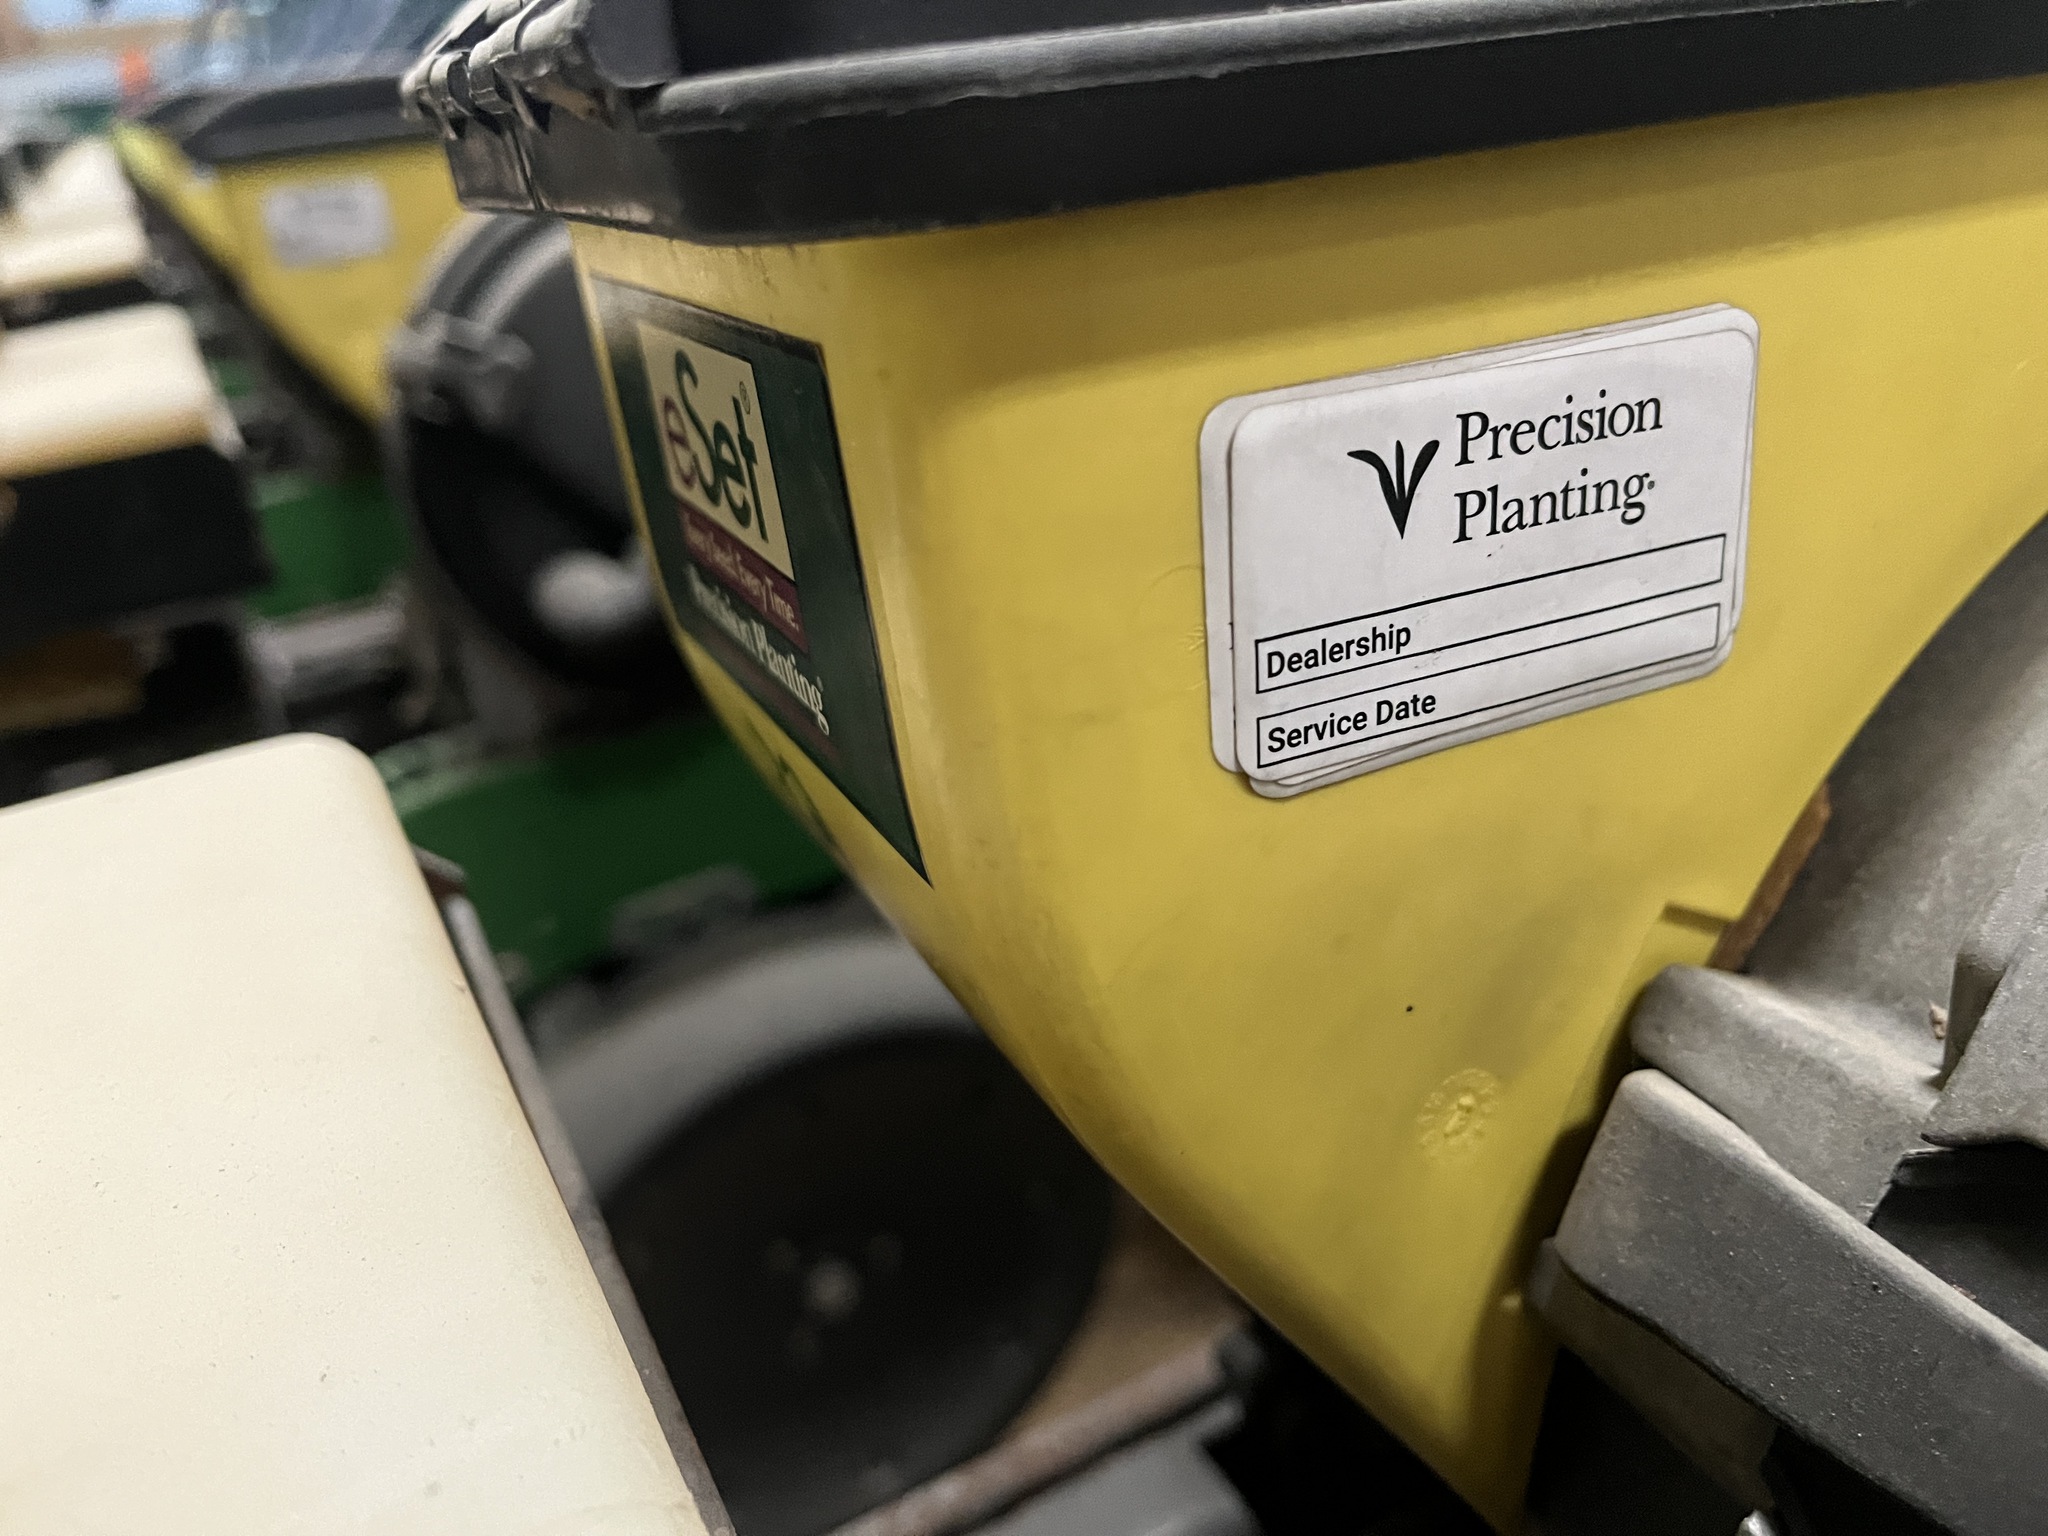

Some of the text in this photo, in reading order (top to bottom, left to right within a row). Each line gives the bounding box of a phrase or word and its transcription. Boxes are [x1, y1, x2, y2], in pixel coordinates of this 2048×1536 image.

[1454, 389, 1663, 467] Precision
[1453, 467, 1656, 543] Planting
[749, 614, 830, 736] Planting
[1267, 622, 1412, 678] Dealership
[1267, 692, 1437, 753] Service Date
